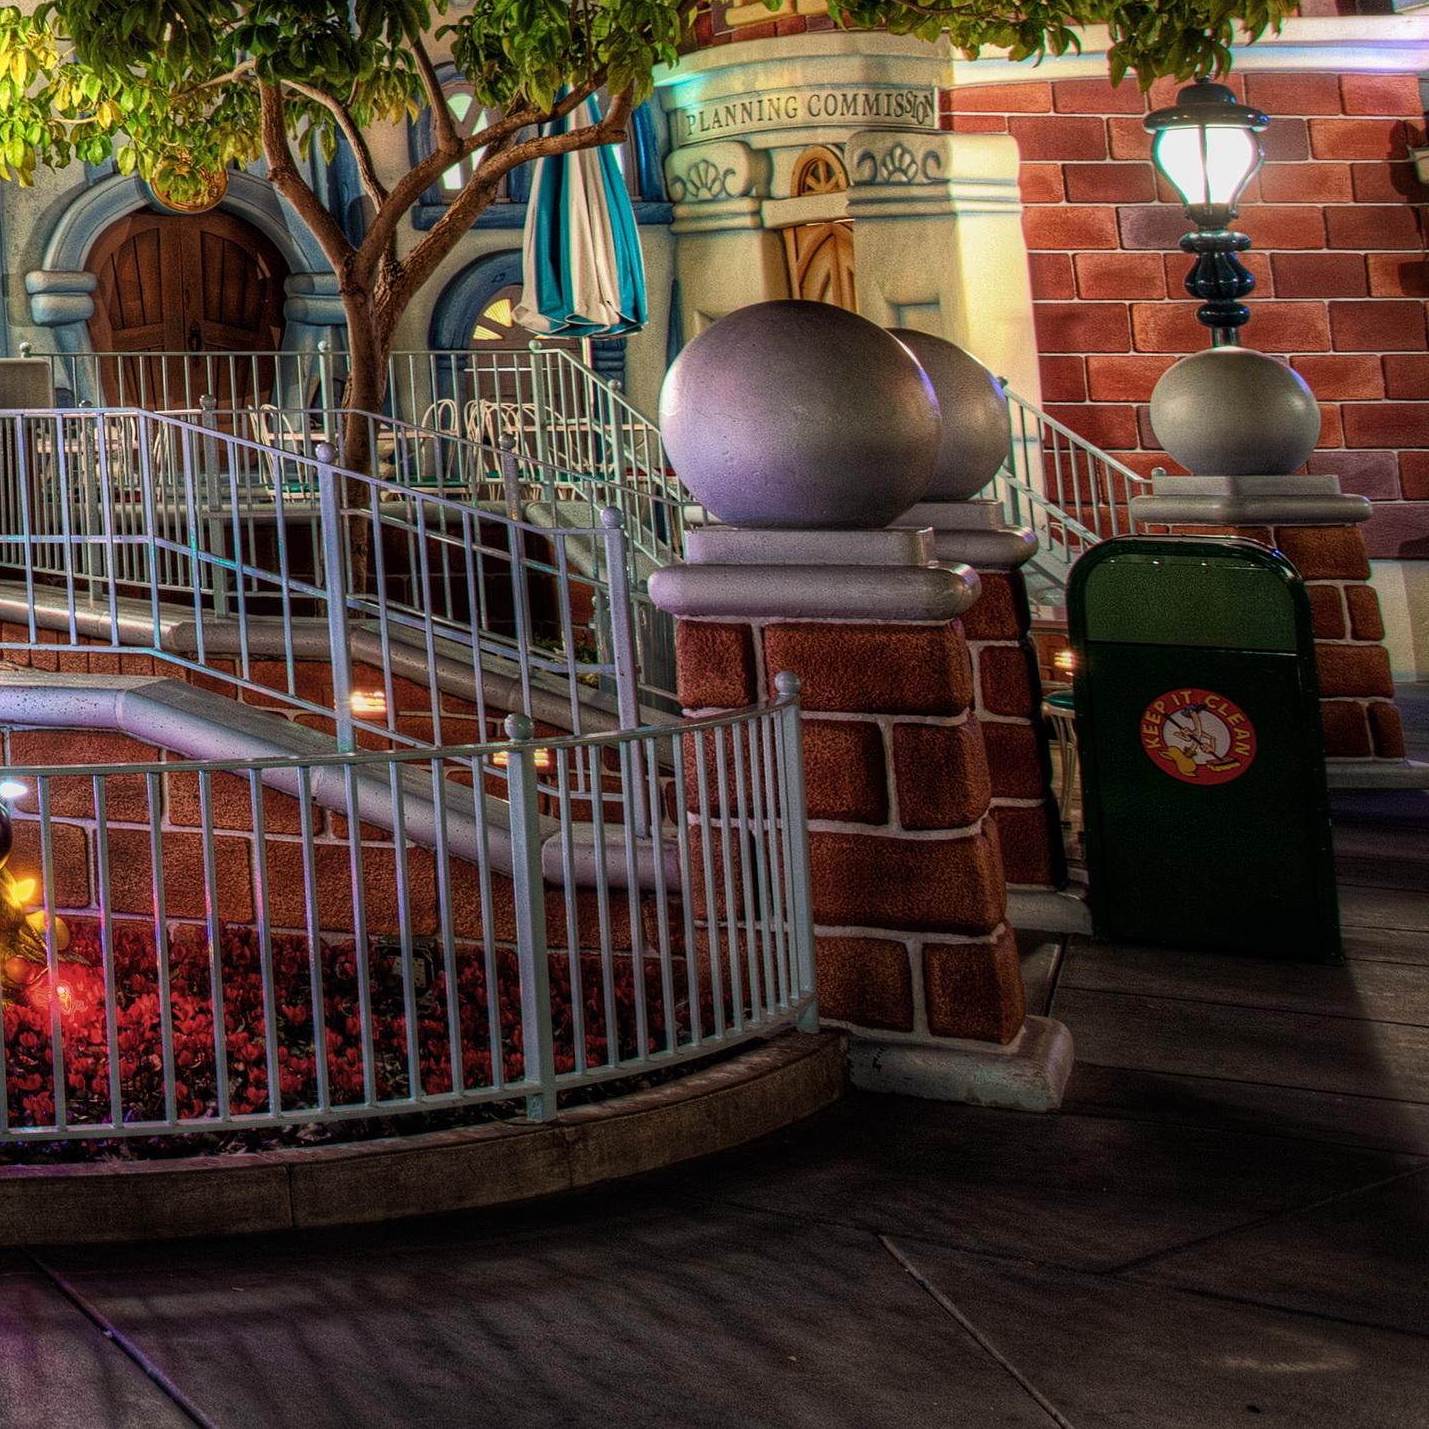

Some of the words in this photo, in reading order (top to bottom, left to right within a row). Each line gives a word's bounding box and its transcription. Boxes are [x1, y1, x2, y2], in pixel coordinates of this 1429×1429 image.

[686, 96, 798, 137] PLANNING
[807, 90, 934, 125] COMMISSION
[1143, 700, 1165, 749] KEEP
[1172, 691, 1192, 706] IT
[1205, 695, 1251, 755] CLEAN
